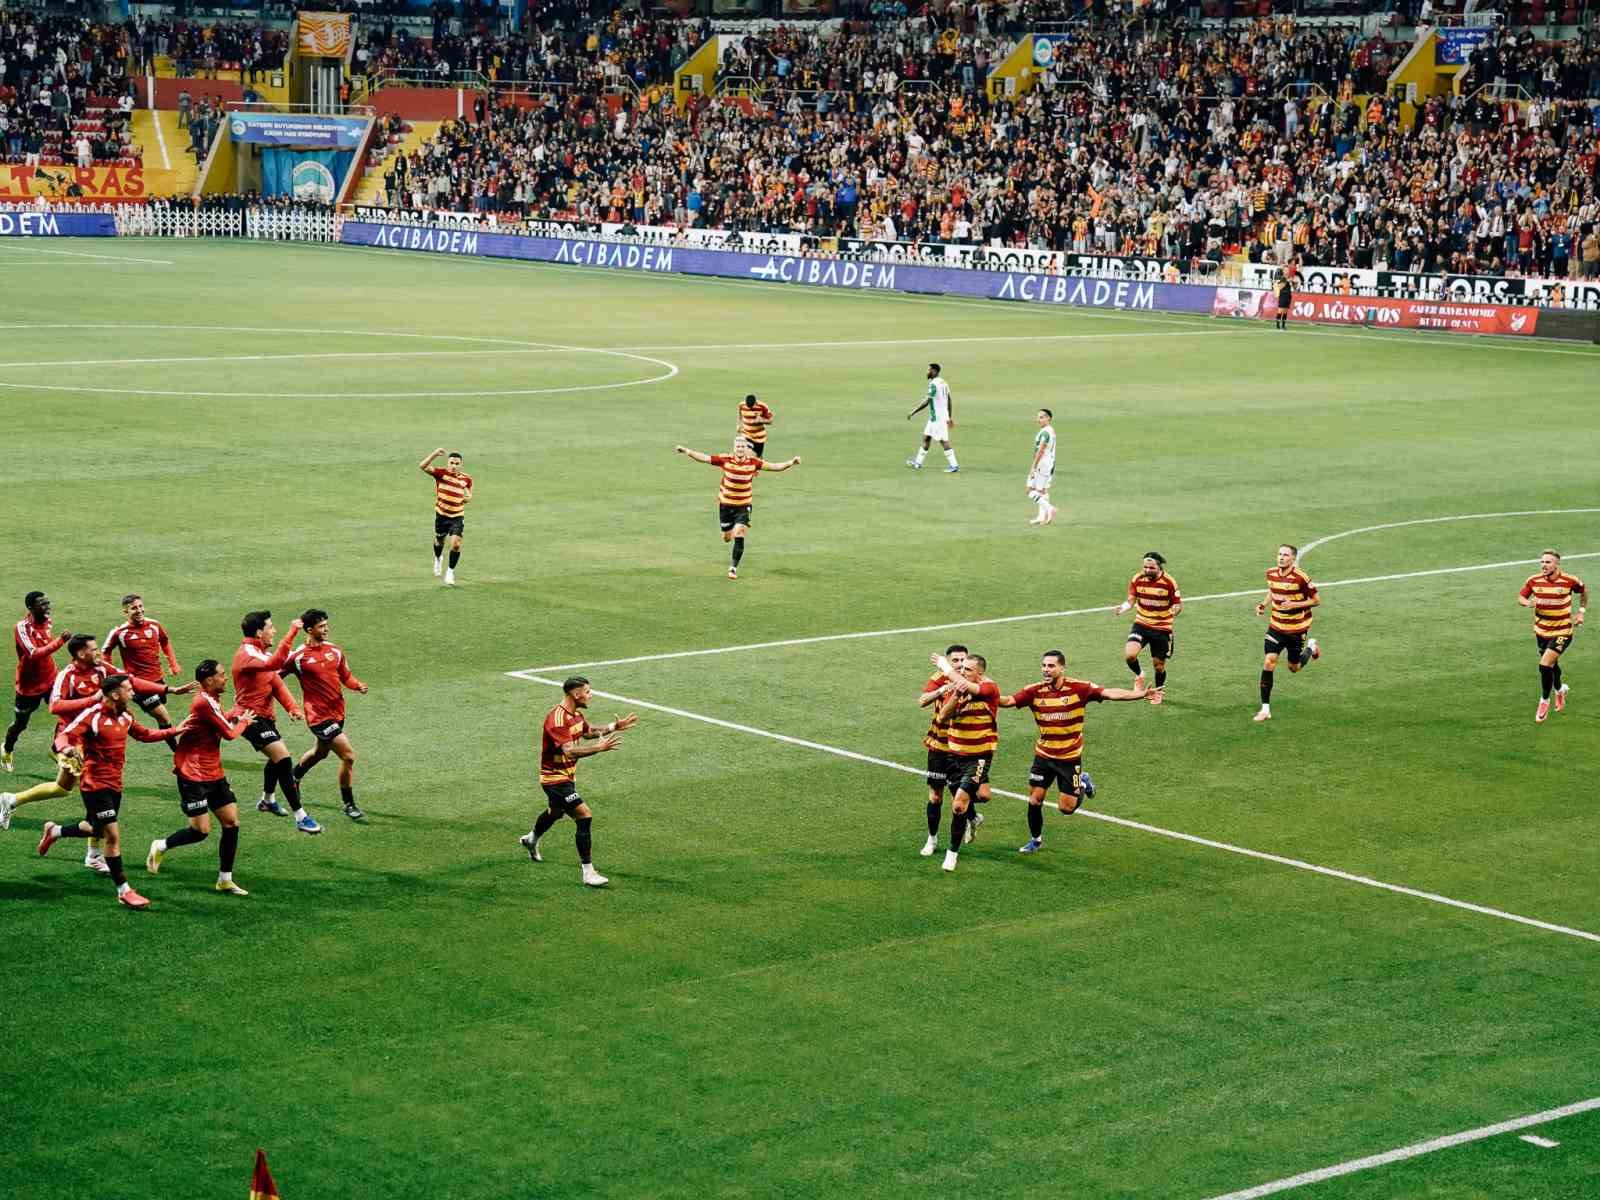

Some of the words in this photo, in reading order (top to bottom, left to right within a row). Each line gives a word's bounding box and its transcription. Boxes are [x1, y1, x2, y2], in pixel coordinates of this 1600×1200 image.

[375, 225, 479, 254] ACIBADEM
[555, 239, 673, 271] ACIBADEM
[754, 257, 896, 290] ACIBADEM
[999, 273, 1155, 310] ACIBADEM
[1292, 302, 1315, 318] 30
